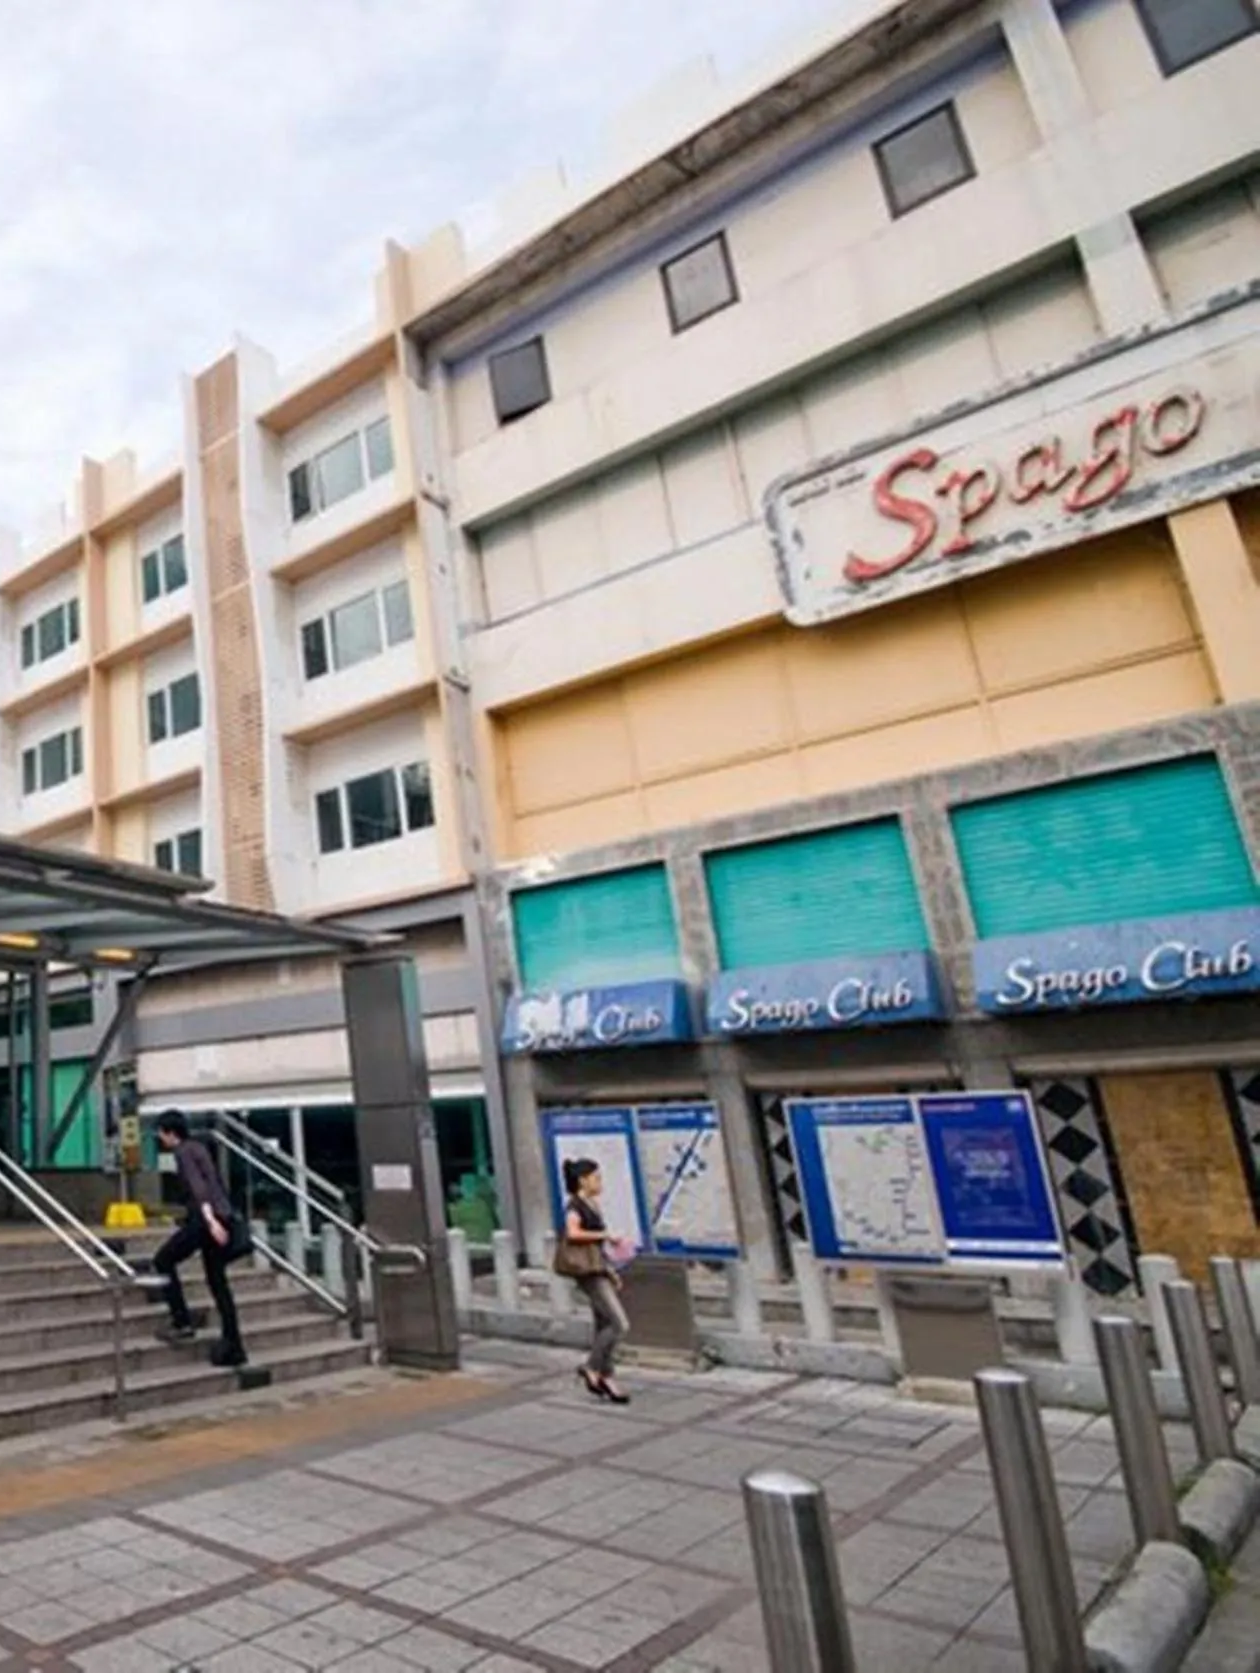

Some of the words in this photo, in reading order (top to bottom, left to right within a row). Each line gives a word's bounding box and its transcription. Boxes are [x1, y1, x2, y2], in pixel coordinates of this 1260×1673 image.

[843, 389, 1206, 583] Spago
[996, 956, 1128, 1006] Spago
[1141, 938, 1254, 992] Club
[592, 1003, 663, 1043] Club
[720, 987, 820, 1031] Spago
[827, 976, 913, 1023] Club
